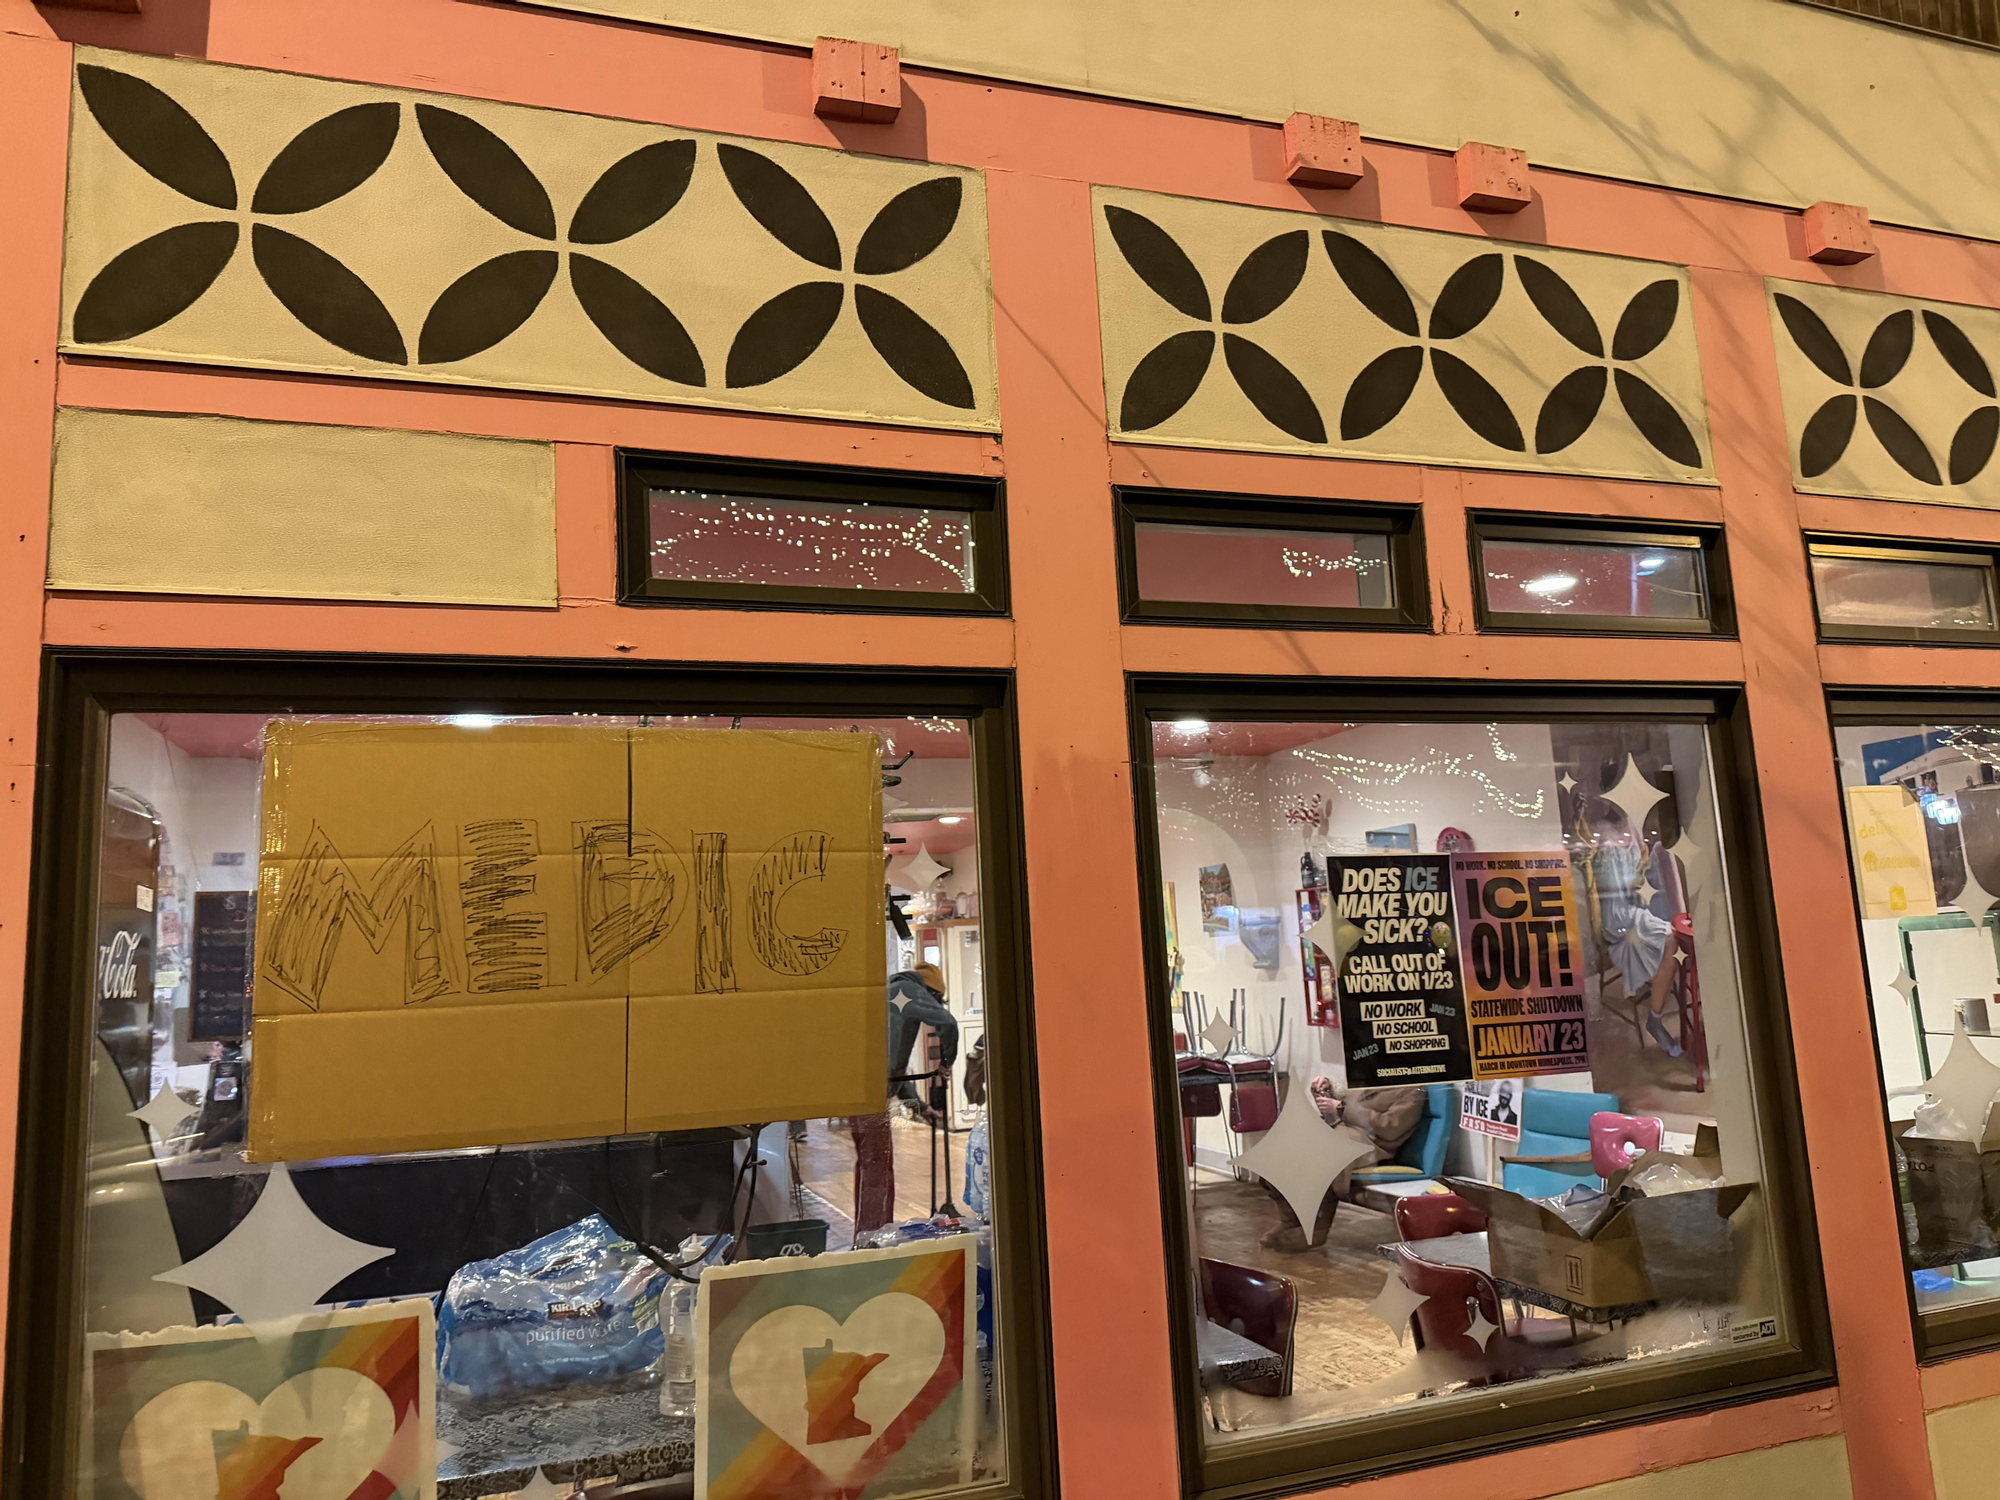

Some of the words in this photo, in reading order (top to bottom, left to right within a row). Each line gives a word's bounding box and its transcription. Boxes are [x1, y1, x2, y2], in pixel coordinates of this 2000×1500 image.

[1456, 861, 1464, 870] NO
[1487, 860, 1496, 870] NO
[1525, 859, 1534, 869] NO
[1342, 867, 1402, 892] DOES
[1404, 866, 1439, 891] ICE
[1338, 893, 1401, 919] MAKE
[1405, 892, 1448, 917] YOU
[1465, 876, 1565, 919] ICE
[262, 818, 849, 1012] MEDIC
[1363, 917, 1429, 944] SICK?
[1349, 955, 1391, 974] CALL
[1391, 953, 1423, 972] OUT
[1425, 953, 1446, 971] OF
[1471, 920, 1574, 992] OUT!
[1343, 973, 1396, 994] WORK
[1397, 972, 1420, 991] ON
[1421, 971, 1454, 990] 1/23
[1364, 1004, 1382, 1019] NO
[1385, 1002, 1422, 1017] WORK
[1429, 1003, 1444, 1014] JAN
[1444, 1006, 1456, 1017] 23
[1471, 997, 1525, 1018] STATEWIDE
[1527, 994, 1584, 1015] SHUTDOWN
[1376, 1023, 1391, 1036] NO
[1393, 1021, 1434, 1035] SCHOOL
[1477, 1023, 1556, 1057] JANUARY
[1560, 1021, 1585, 1051] 23
[1352, 1047, 1369, 1061] JAN
[1368, 1043, 1379, 1054] 23
[1389, 1040, 1402, 1051] NO
[1403, 1038, 1446, 1050] SHOPPING
[1499, 1060, 1506, 1070] IN
[1464, 1095, 1475, 1115] BY
[1476, 1098, 1489, 1118] ICE
[551, 1299, 601, 1316] KIRAND
[526, 1325, 585, 1346] purified
[588, 1319, 626, 1338] water
[1733, 1331, 1753, 1340] secured
[1753, 1330, 1759, 1338] by
[1761, 1323, 1775, 1334] ADT
